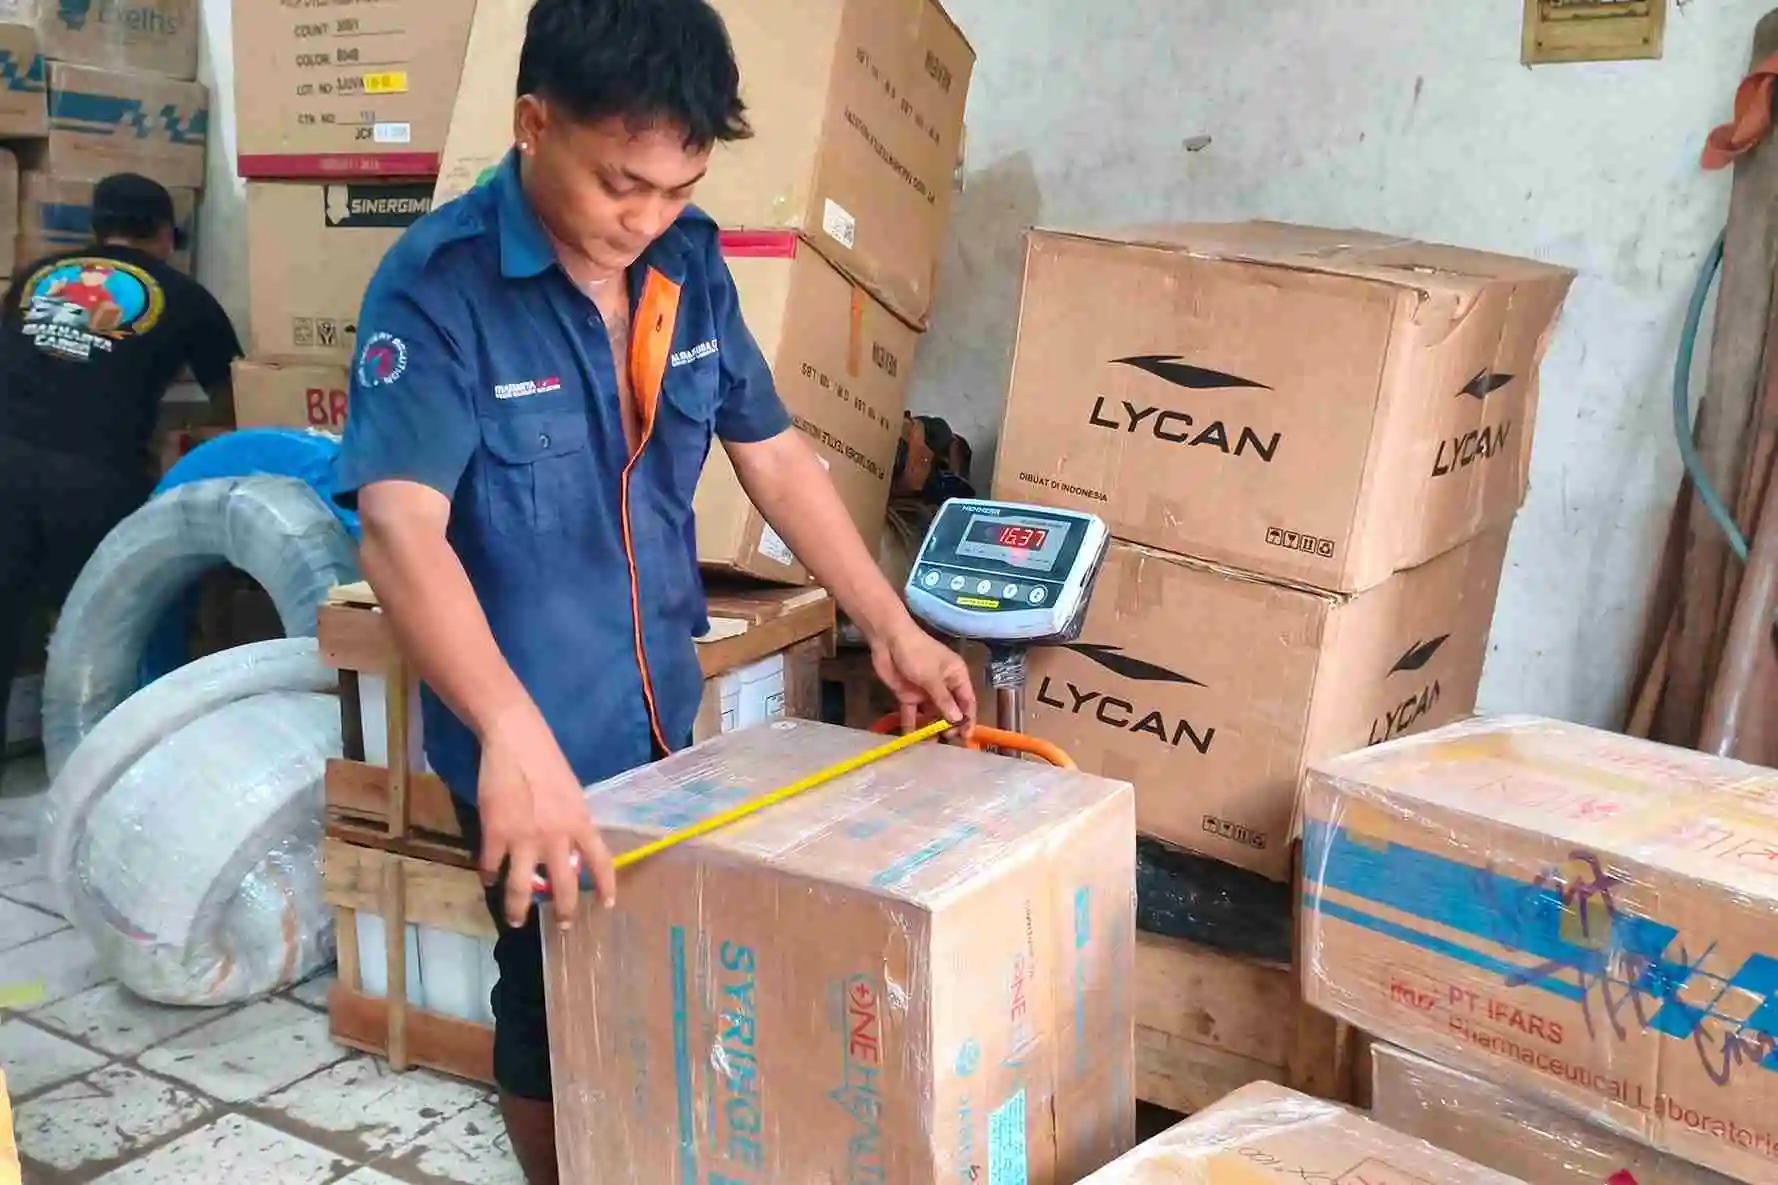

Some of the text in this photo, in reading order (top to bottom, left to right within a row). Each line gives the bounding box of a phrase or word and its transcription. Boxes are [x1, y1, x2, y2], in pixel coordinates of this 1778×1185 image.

[1088, 396, 1282, 463] LYCAN
[1431, 421, 1511, 477] LYCAN
[1019, 471, 1108, 502] DIBUAT DI INDONESIA
[1036, 676, 1216, 755] LYCAN
[1367, 679, 1441, 747] LYCAN
[1449, 985, 1480, 1013] PT
[1487, 999, 1564, 1045] IFARS
